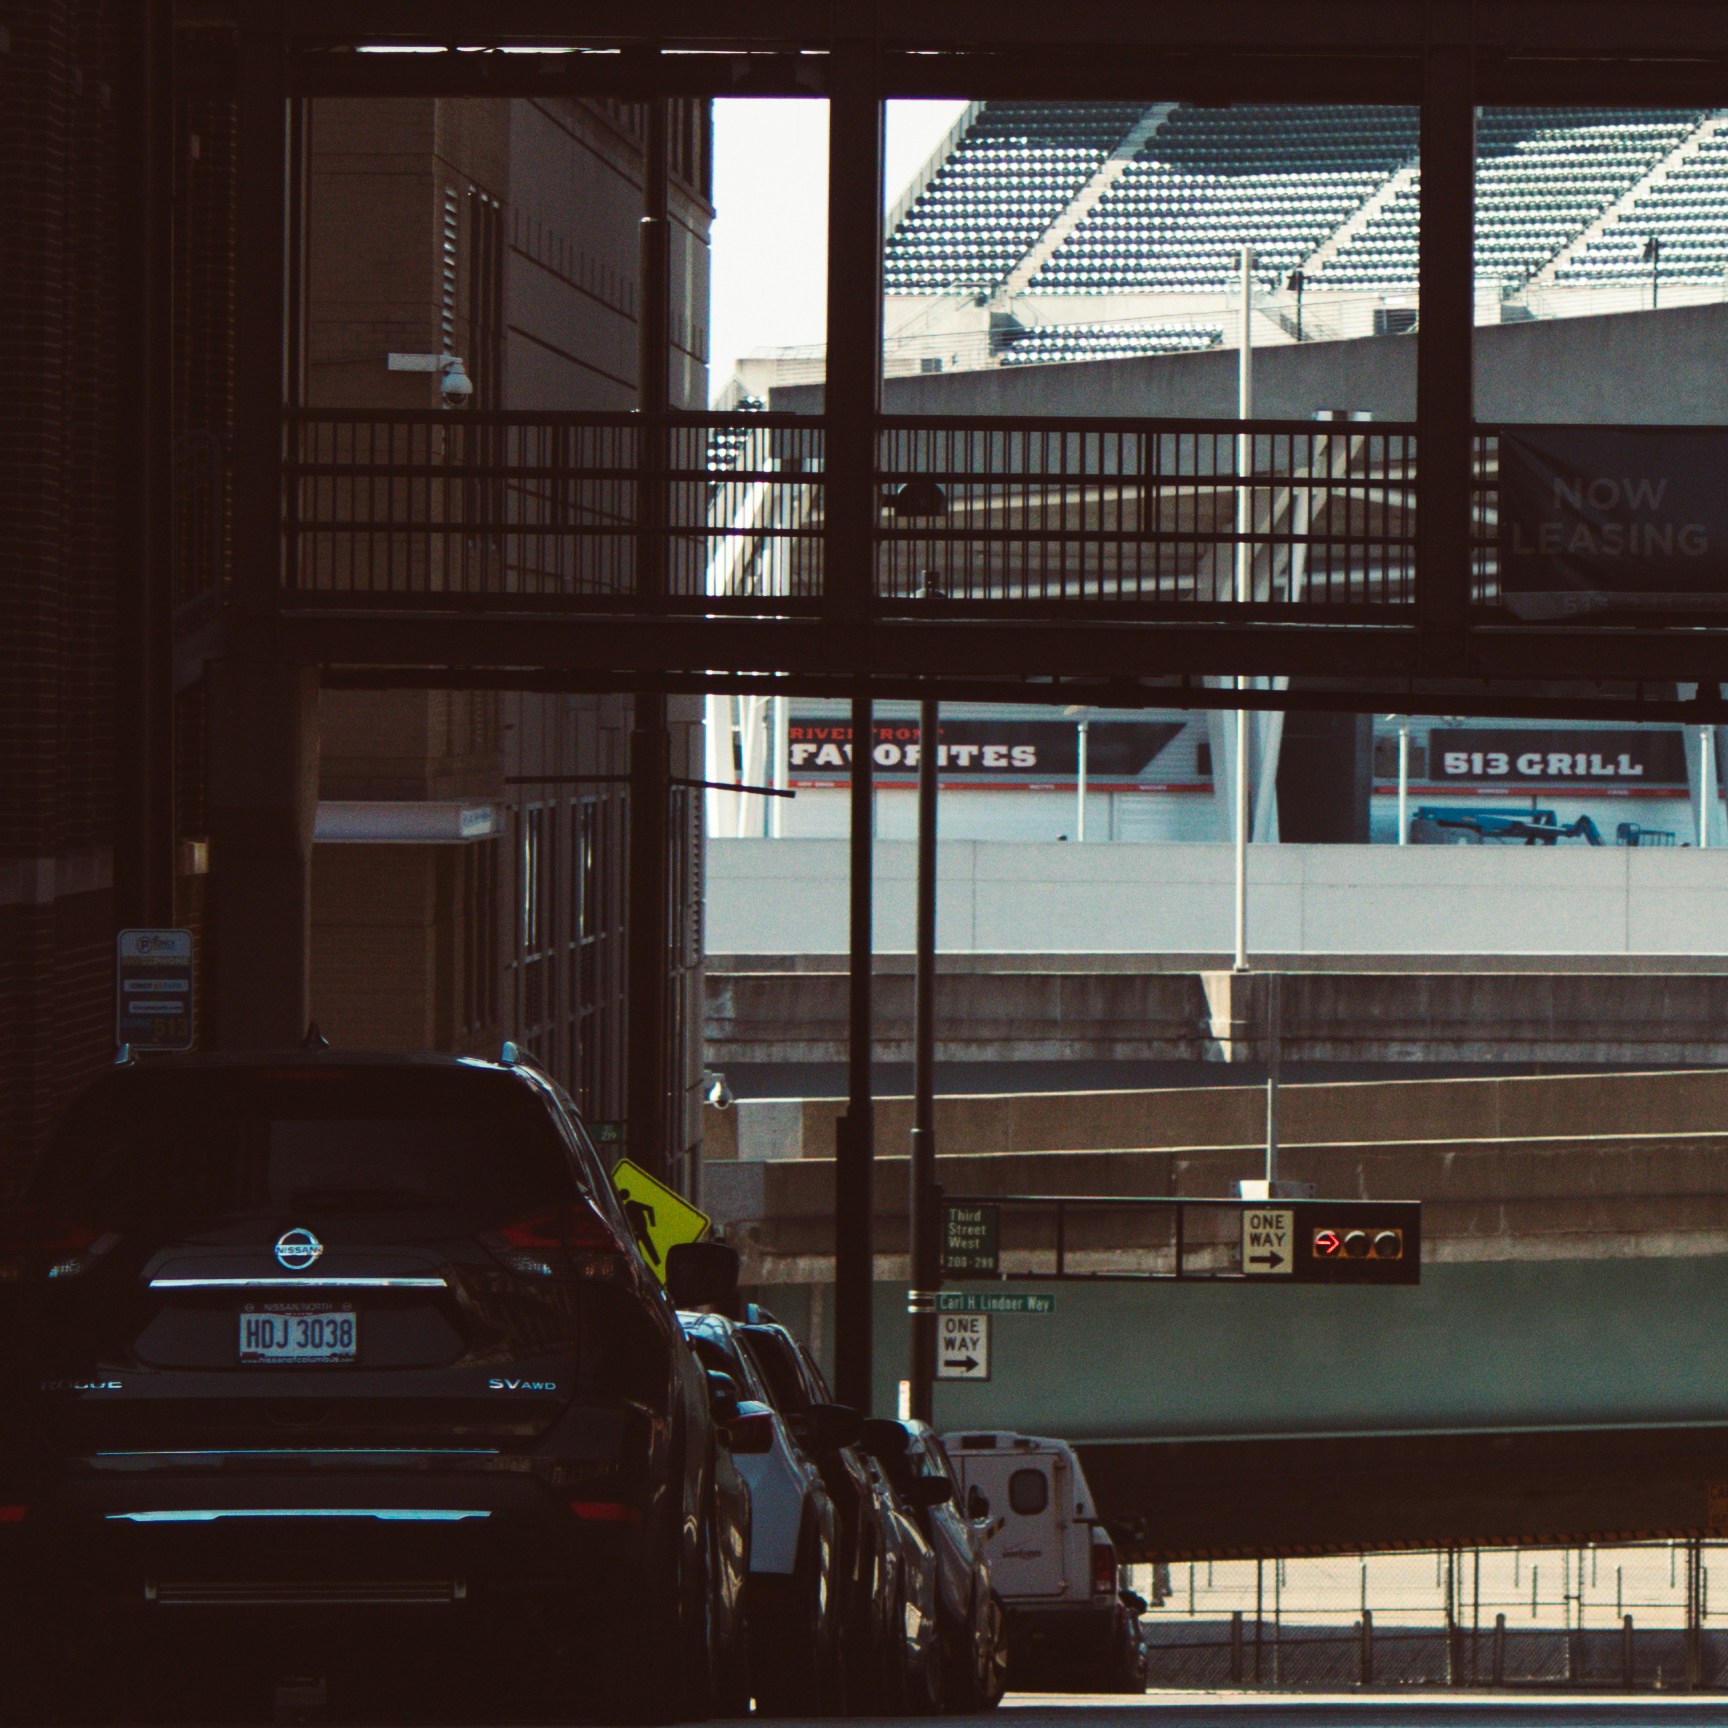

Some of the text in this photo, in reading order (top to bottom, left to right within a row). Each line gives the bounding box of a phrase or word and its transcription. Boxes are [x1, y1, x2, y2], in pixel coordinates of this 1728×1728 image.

[1553, 478, 1668, 512] NOW
[1512, 522, 1710, 557] LEASING
[1444, 752, 1643, 776] 513 GRILL
[949, 1208, 982, 1222] Third
[1250, 1214, 1285, 1230] ONE
[948, 1222, 987, 1235] Street
[948, 1237, 981, 1250] West
[1250, 1232, 1286, 1247] WAY
[277, 1245, 324, 1255] NISSAN
[940, 1295, 964, 1309] Carl
[980, 1295, 1024, 1309] Lindner
[1027, 1296, 1050, 1311] Way
[945, 1318, 981, 1333] ONE
[246, 1319, 353, 1348] HDJ 3038
[944, 1336, 981, 1351] WAY
[488, 1378, 521, 1389] SV
